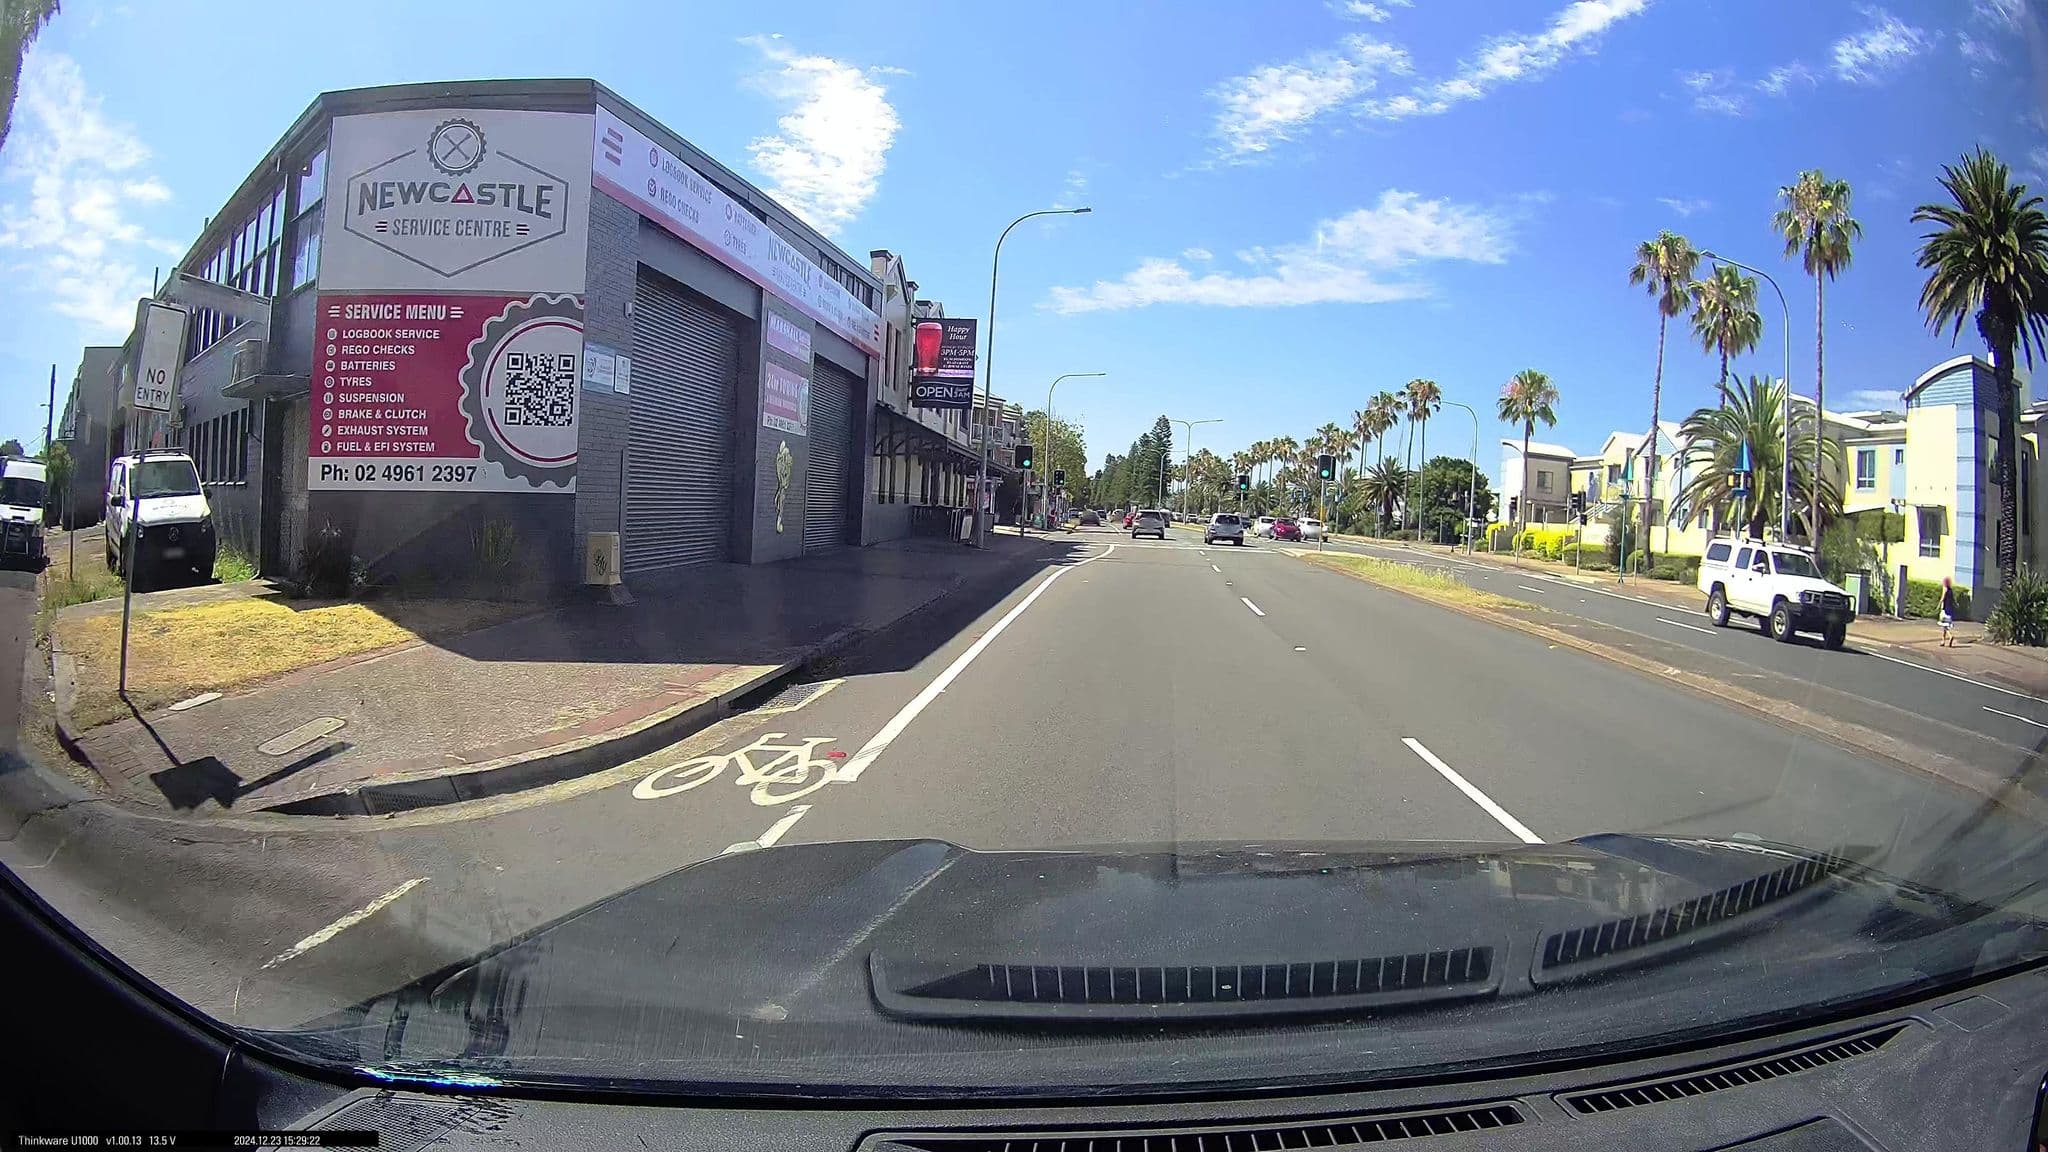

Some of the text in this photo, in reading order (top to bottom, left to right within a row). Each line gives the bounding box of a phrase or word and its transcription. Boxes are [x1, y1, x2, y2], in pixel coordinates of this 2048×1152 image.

[358, 181, 554, 219] NEWCASTLE
[392, 219, 511, 237] SERVICE CENTRE
[345, 304, 446, 320] SERVICE MENU
[342, 330, 440, 339] LOGBOOK SERVICE
[947, 325, 970, 334] Happy
[341, 345, 415, 355] REGO CHECKS
[340, 361, 396, 371] BATTERIES
[147, 368, 166, 385] NO
[340, 377, 372, 386] TYRES
[137, 387, 170, 404] ENTRY
[915, 386, 953, 398] OPEN
[338, 393, 404, 403] SUSPENSION
[338, 410, 426, 419] BRAKE & CLUTCH
[337, 426, 428, 436] EXHAUST SYSTEM
[336, 442, 435, 452] FUEL & EFI SYSTEM
[320, 464, 477, 482] Ph: 02 4961 2397
